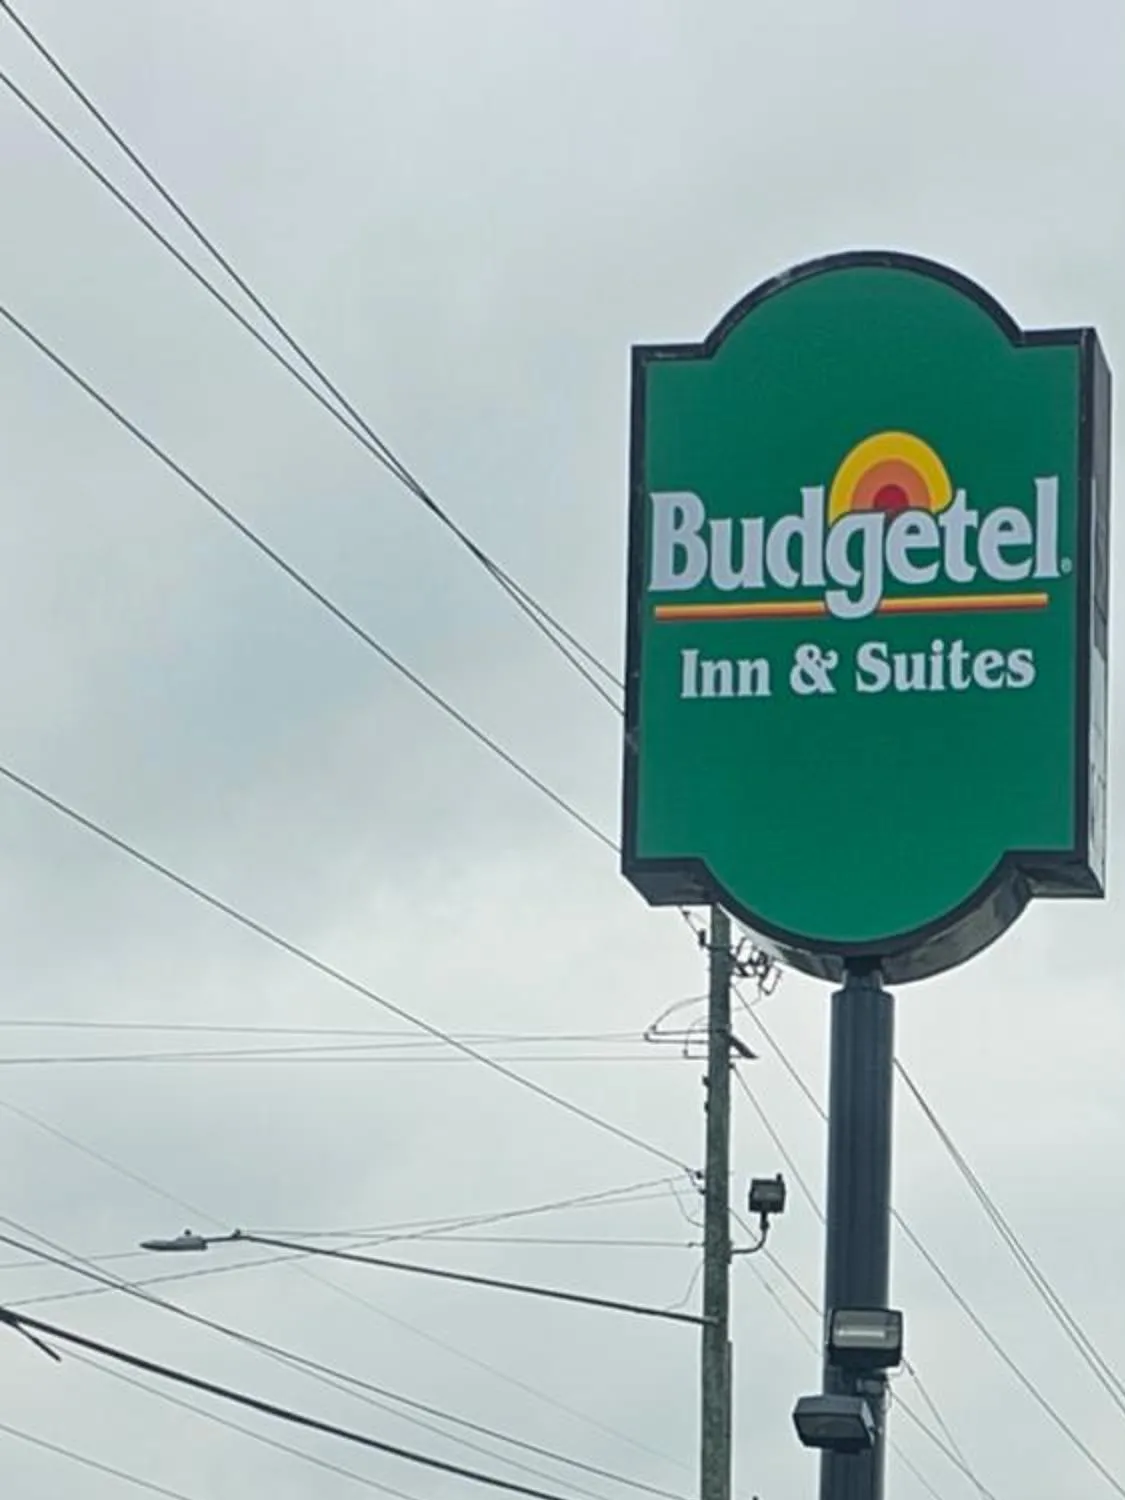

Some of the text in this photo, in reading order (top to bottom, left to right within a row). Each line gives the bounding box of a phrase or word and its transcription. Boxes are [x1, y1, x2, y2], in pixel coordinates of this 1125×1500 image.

[648, 476, 1061, 619] Budgetel
[680, 639, 1037, 699] Inn & Suites
